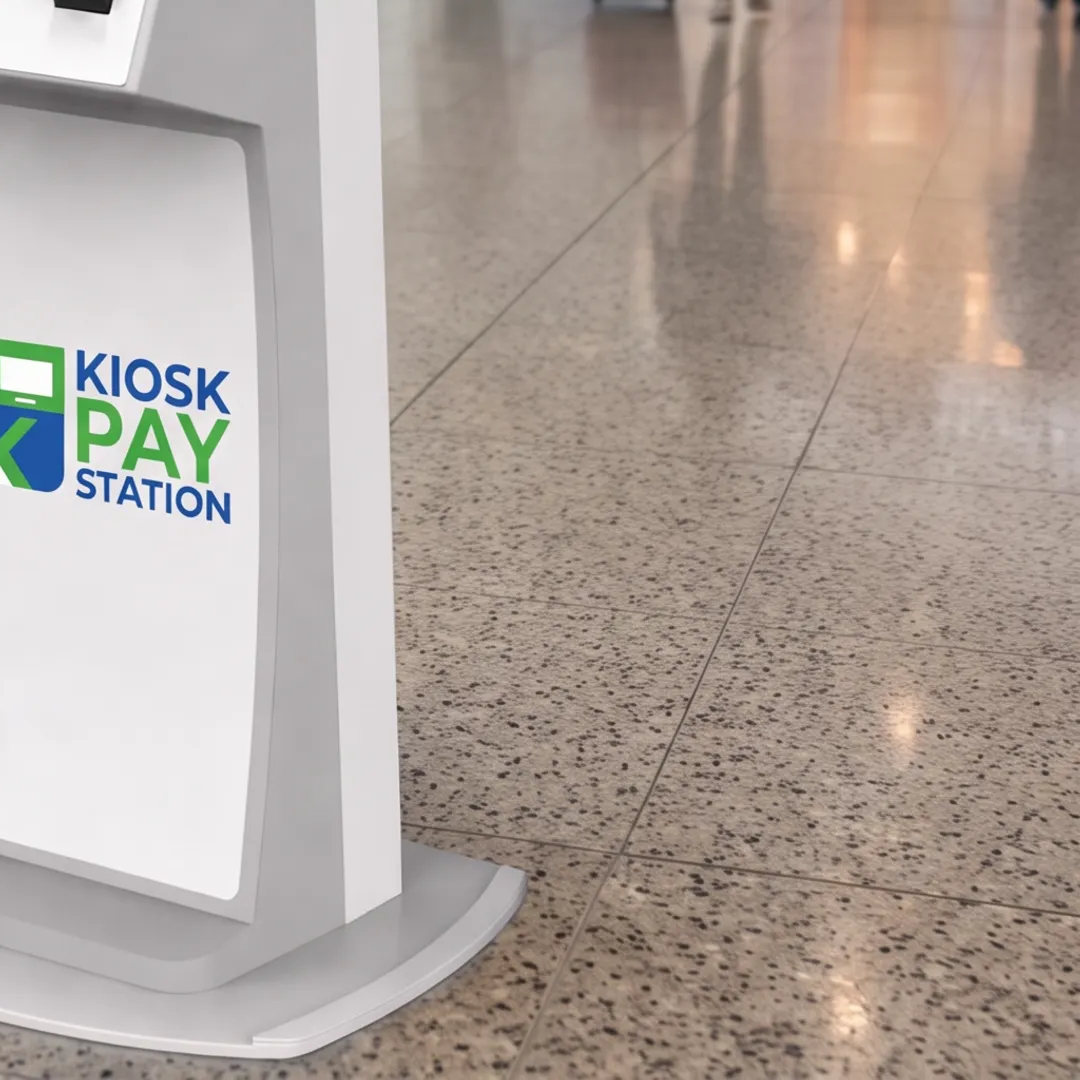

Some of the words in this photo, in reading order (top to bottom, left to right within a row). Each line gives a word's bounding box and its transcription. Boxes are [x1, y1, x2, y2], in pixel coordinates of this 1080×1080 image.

[76, 349, 231, 415] KIOSK
[76, 397, 231, 484] PAY
[76, 467, 231, 525] STATION
